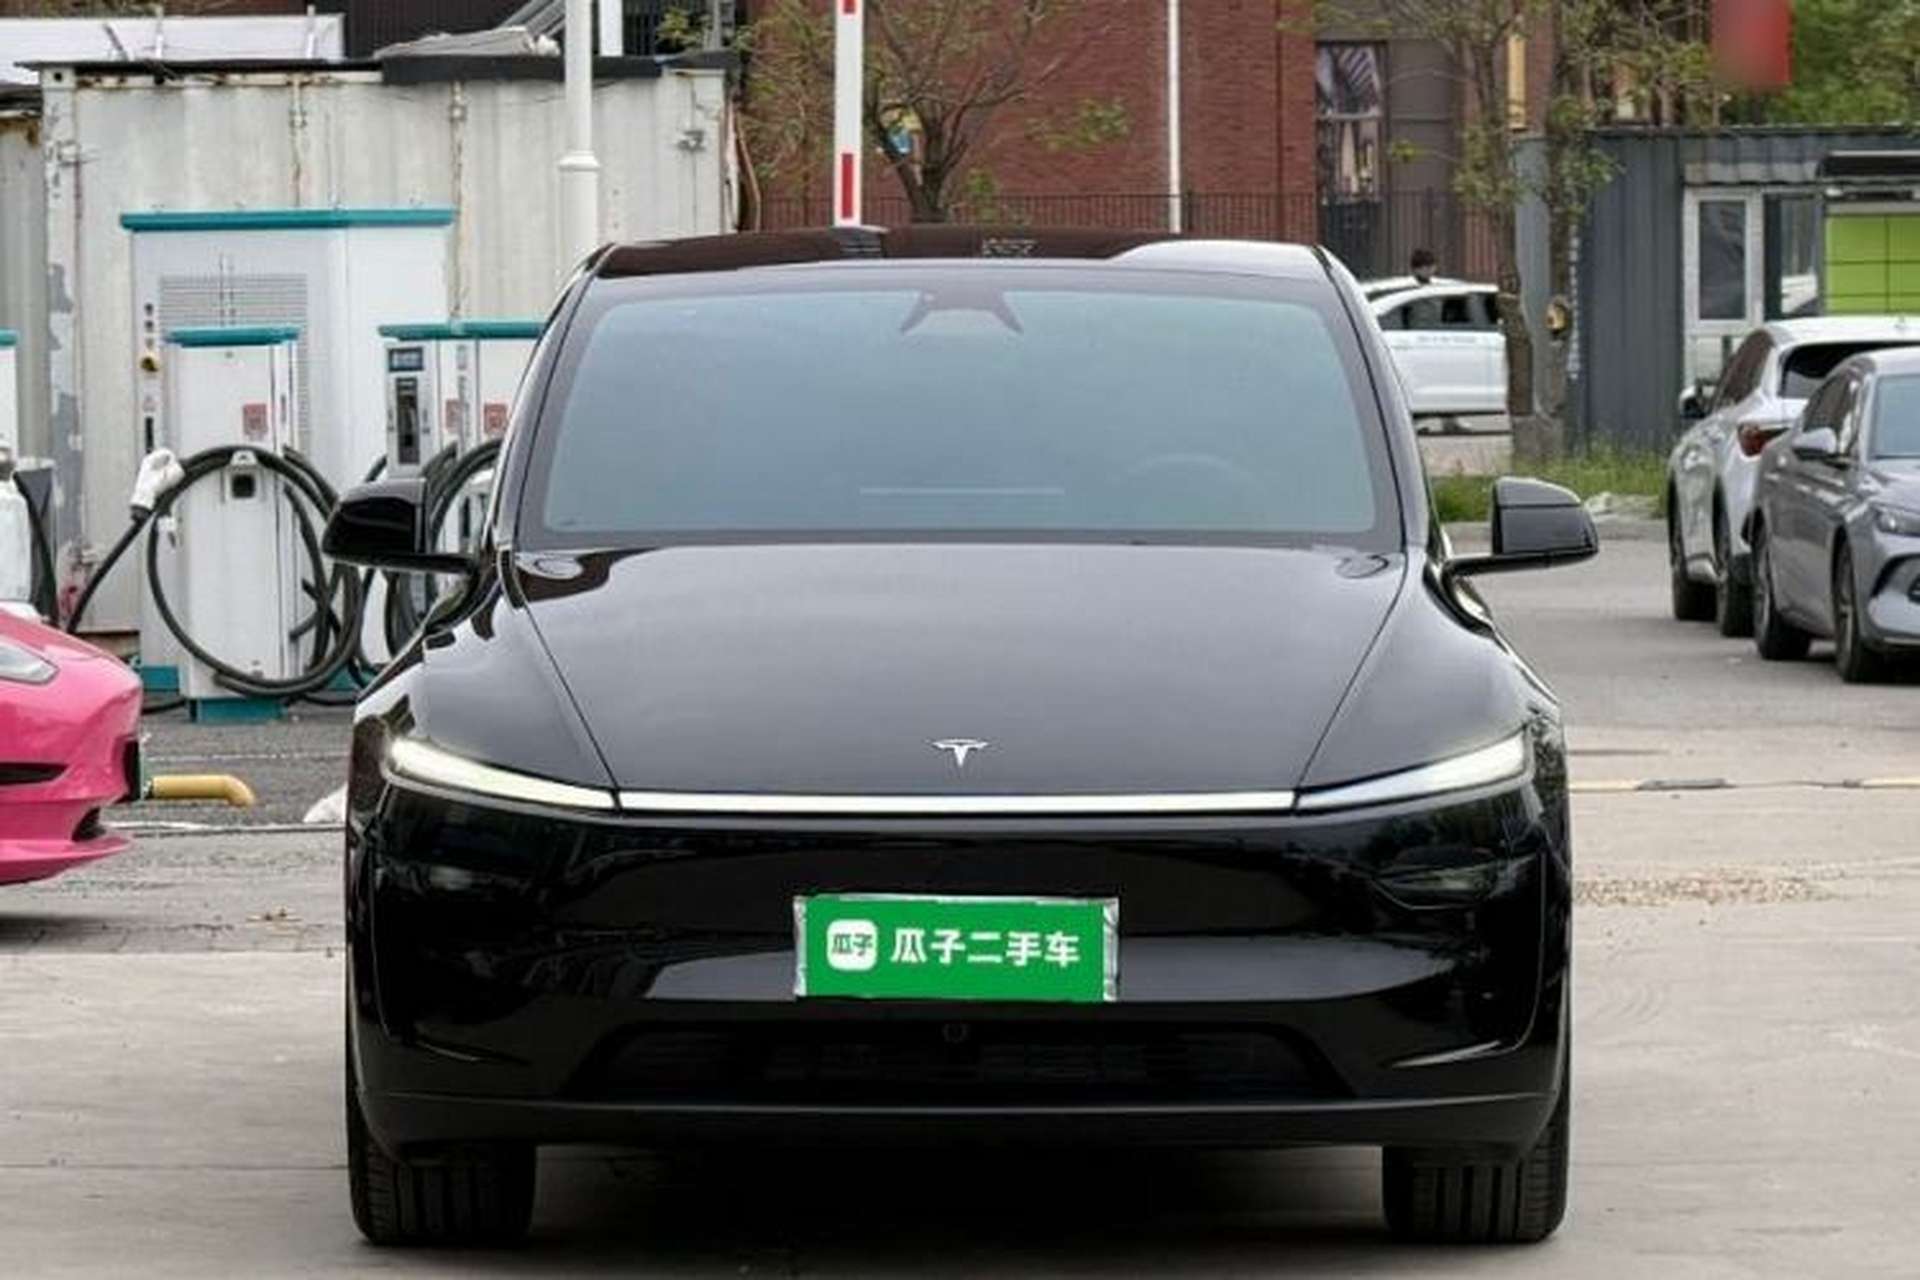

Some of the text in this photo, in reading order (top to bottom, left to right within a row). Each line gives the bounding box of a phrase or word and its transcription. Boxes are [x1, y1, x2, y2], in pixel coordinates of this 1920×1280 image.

[832, 927, 1080, 967] 瓜子 瓜子二手车
